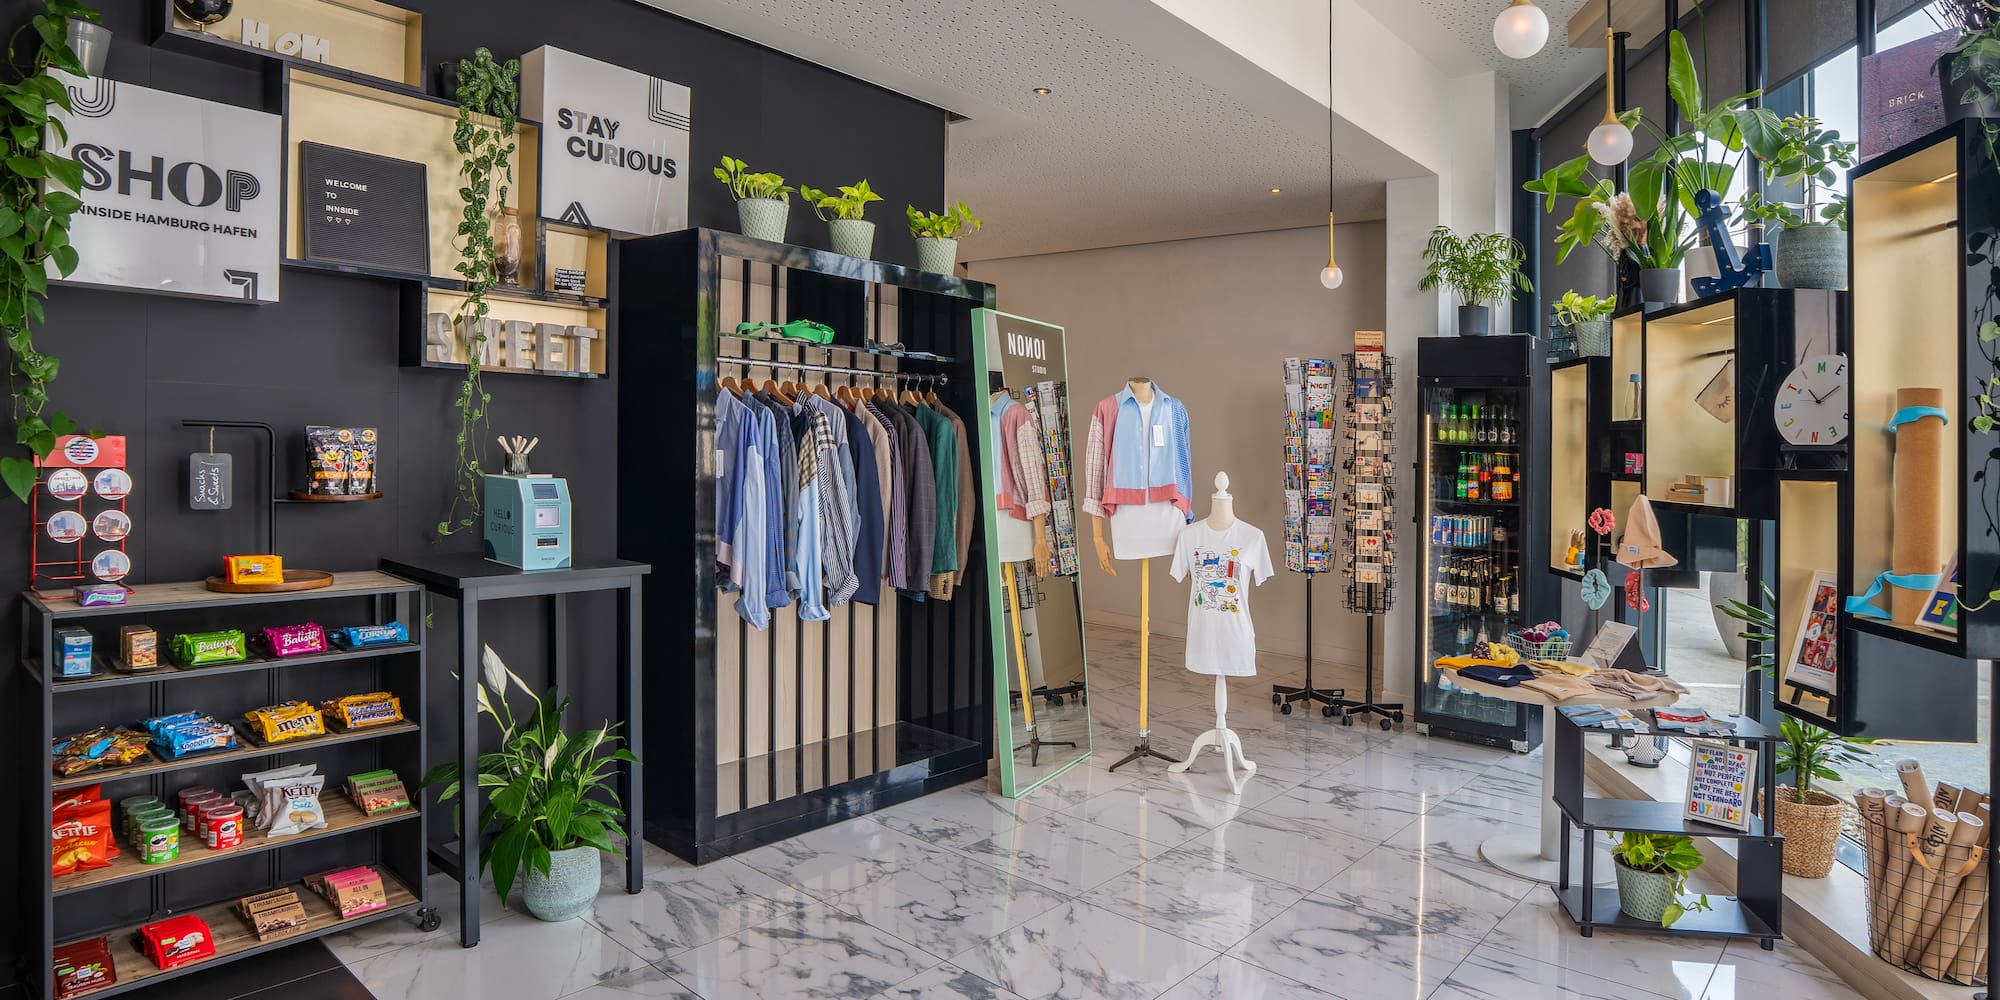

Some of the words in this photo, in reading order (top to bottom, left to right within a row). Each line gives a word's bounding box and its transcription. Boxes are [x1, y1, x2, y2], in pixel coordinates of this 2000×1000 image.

[1888, 89, 1925, 107] BRICK
[557, 107, 620, 140] STAY
[566, 136, 677, 178] CURIOUS
[71, 142, 261, 213] SHOP
[325, 178, 368, 192] WELCOME
[325, 191, 337, 199] TO
[325, 204, 359, 216] INNSIDE
[77, 203, 132, 221] NNSIDE
[136, 212, 210, 232] HAMBURG
[213, 223, 257, 239] HAFEN
[426, 312, 599, 373] SWEET
[194, 468, 206, 503] Snacks
[207, 467, 220, 492] Sweets
[493, 507, 511, 521] HELLO
[197, 637, 235, 654] Balisto
[282, 629, 319, 647] Balisto
[1695, 776, 1706, 784] NOT
[1706, 778, 1734, 788] COMPLETE
[1704, 769, 1716, 777] NOT
[1717, 772, 1744, 784] PERFECT
[1693, 791, 1706, 800] NOT
[1707, 794, 1743, 808] STANDARD
[1699, 783, 1711, 791] NOT
[1712, 786, 1723, 795] THE
[1724, 789, 1740, 799] BEST
[291, 800, 313, 810] Salt
[1690, 800, 1713, 815] BUT
[1713, 805, 1742, 822] NICE
